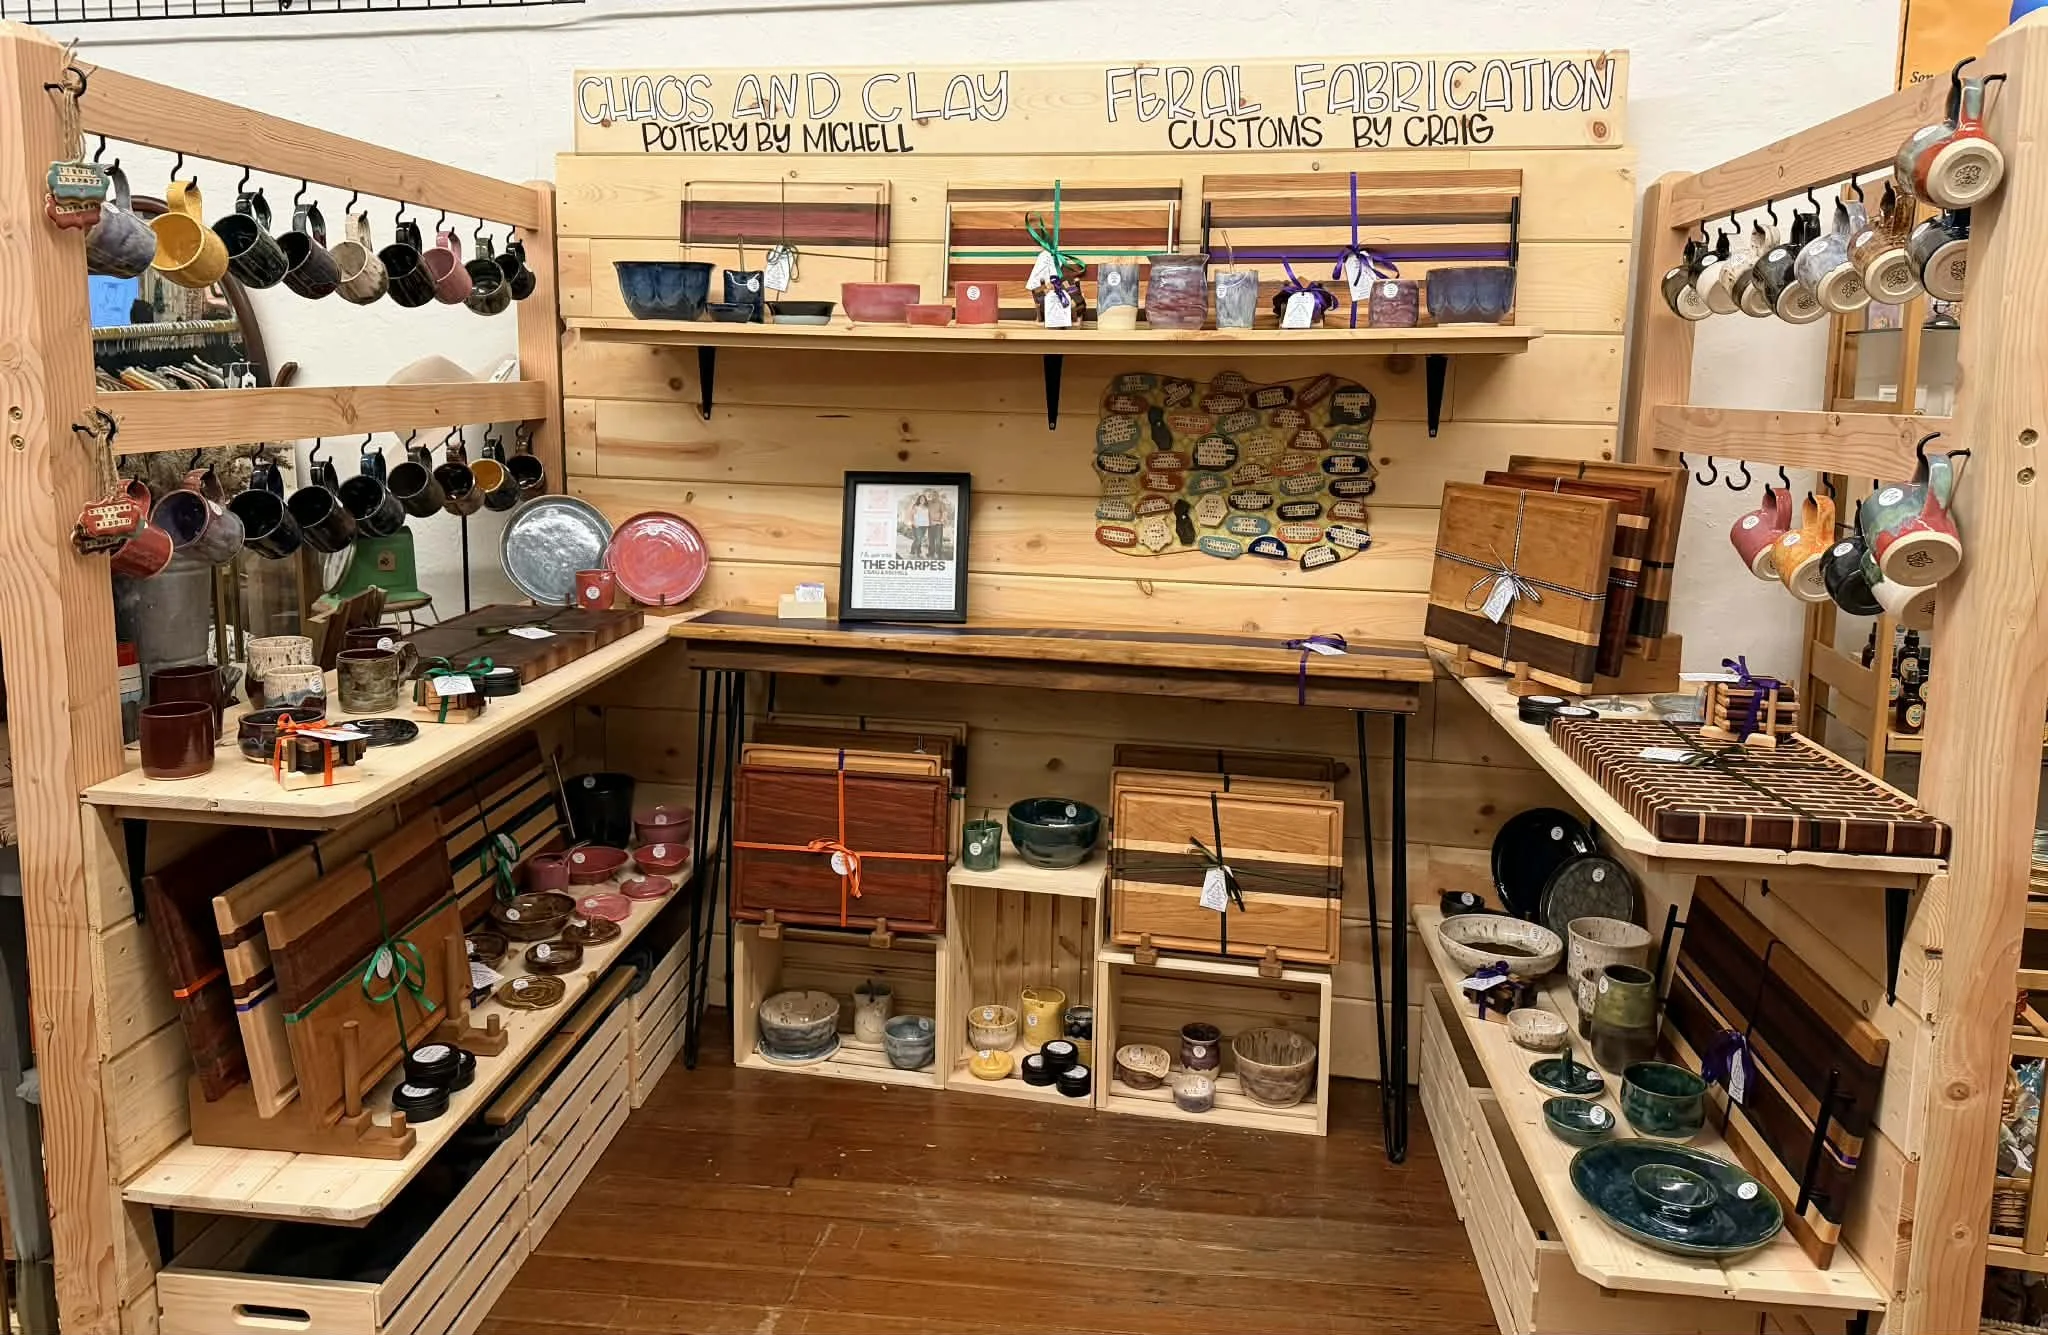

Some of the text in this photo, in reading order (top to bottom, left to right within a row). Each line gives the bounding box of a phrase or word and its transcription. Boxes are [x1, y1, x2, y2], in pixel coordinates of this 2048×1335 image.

[577, 70, 1009, 125] CHAOS AND CLAY
[1105, 58, 1616, 123] FERAL FABRICATION
[641, 121, 914, 154] POTTERY BY MICHELL
[1168, 113, 1494, 150] CUSTOMS BY CRAIG
[861, 559, 946, 571] THE SHARPES
